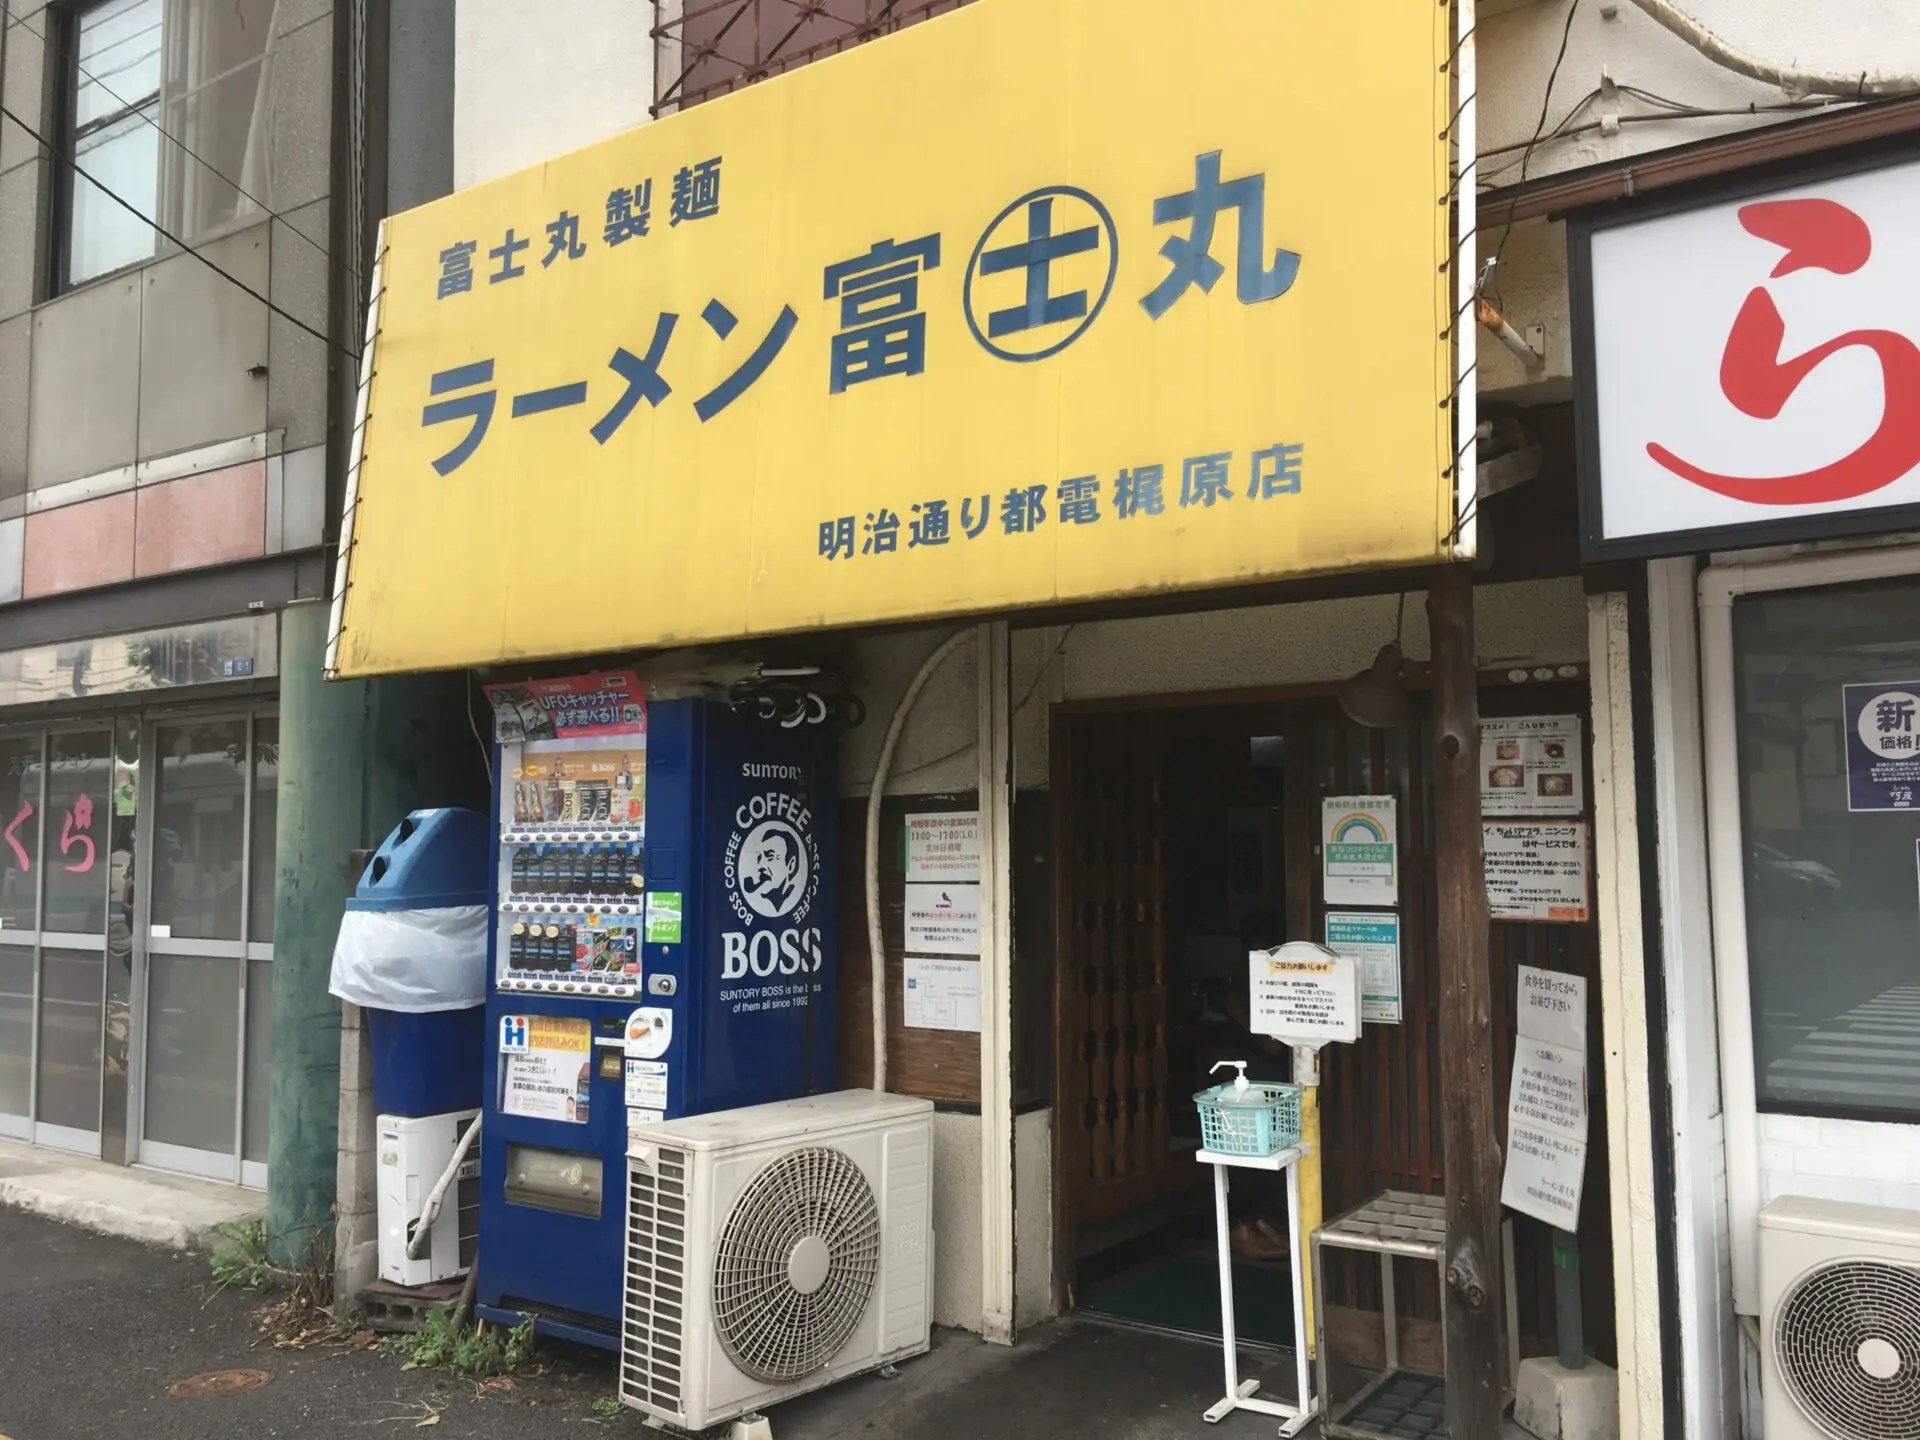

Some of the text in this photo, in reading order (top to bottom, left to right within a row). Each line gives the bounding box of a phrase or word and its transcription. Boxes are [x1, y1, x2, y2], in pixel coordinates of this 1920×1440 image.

[436, 155, 723, 301] 富士丸製麺
[1645, 197, 1920, 506] ら
[818, 443, 1305, 562] 明治通り都電梶原店
[538, 691, 630, 711] UFOキャッチャー
[1876, 700, 1916, 733] 新
[735, 792, 812, 833] COFFEE
[723, 830, 742, 890] COFFEE
[721, 927, 822, 980] BOSS
[720, 988, 761, 1002] SUNTORY
[761, 985, 784, 997] BOSS
[785, 984, 792, 995] is
[792, 983, 805, 994] the
[733, 1002, 742, 1014] of
[742, 1001, 761, 1012] them
[762, 999, 771, 1010] all
[772, 998, 791, 1009] since
